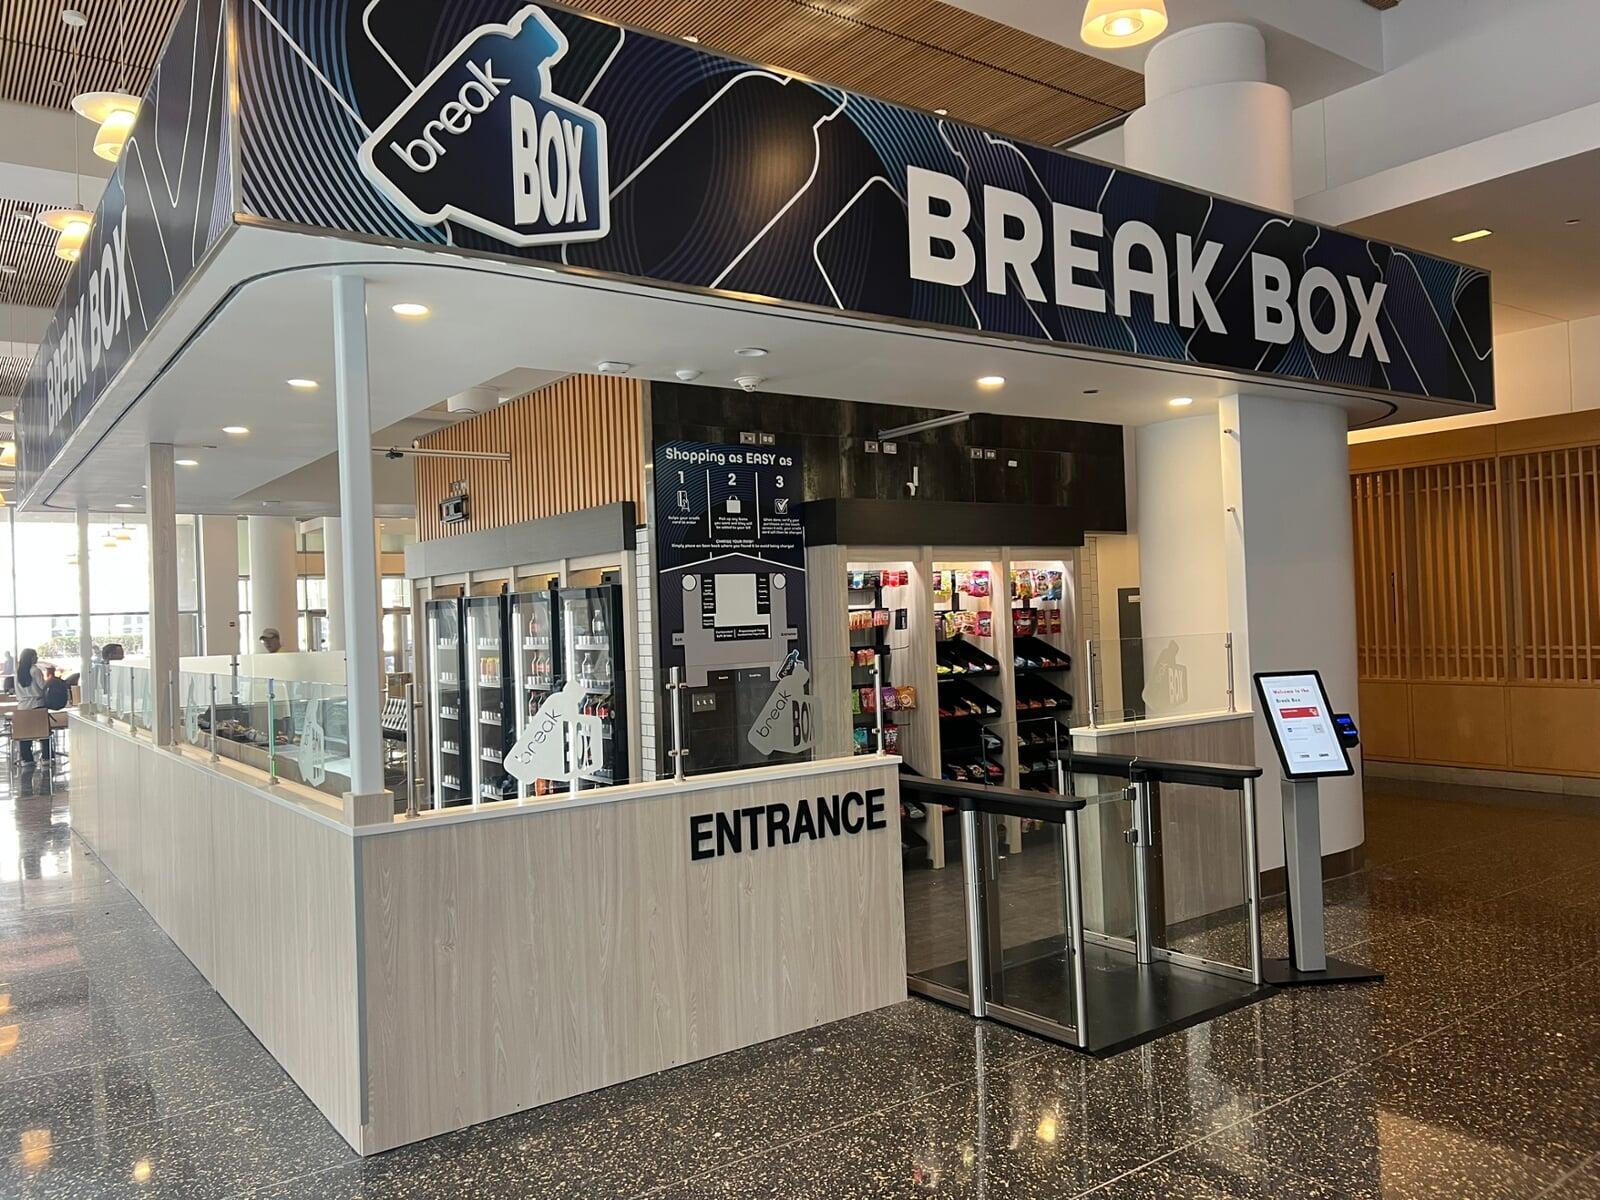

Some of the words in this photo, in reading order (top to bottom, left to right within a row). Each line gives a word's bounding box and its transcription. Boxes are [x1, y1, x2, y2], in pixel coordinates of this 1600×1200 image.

[389, 57, 512, 174] break
[510, 94, 587, 227] BOX
[906, 164, 1228, 335] BREAK
[1251, 250, 1392, 364] BOX
[46, 296, 87, 436] BREAK
[89, 204, 132, 372] BOX
[665, 447, 726, 466] Shopping
[728, 454, 743, 464] as
[746, 452, 776, 465] EASY
[779, 456, 793, 467] as
[678, 470, 685, 484] 1
[727, 473, 737, 486] 2
[775, 475, 784, 488] 3
[514, 708, 562, 765] break
[756, 689, 792, 738] break
[690, 787, 887, 861] ENTRANCE
